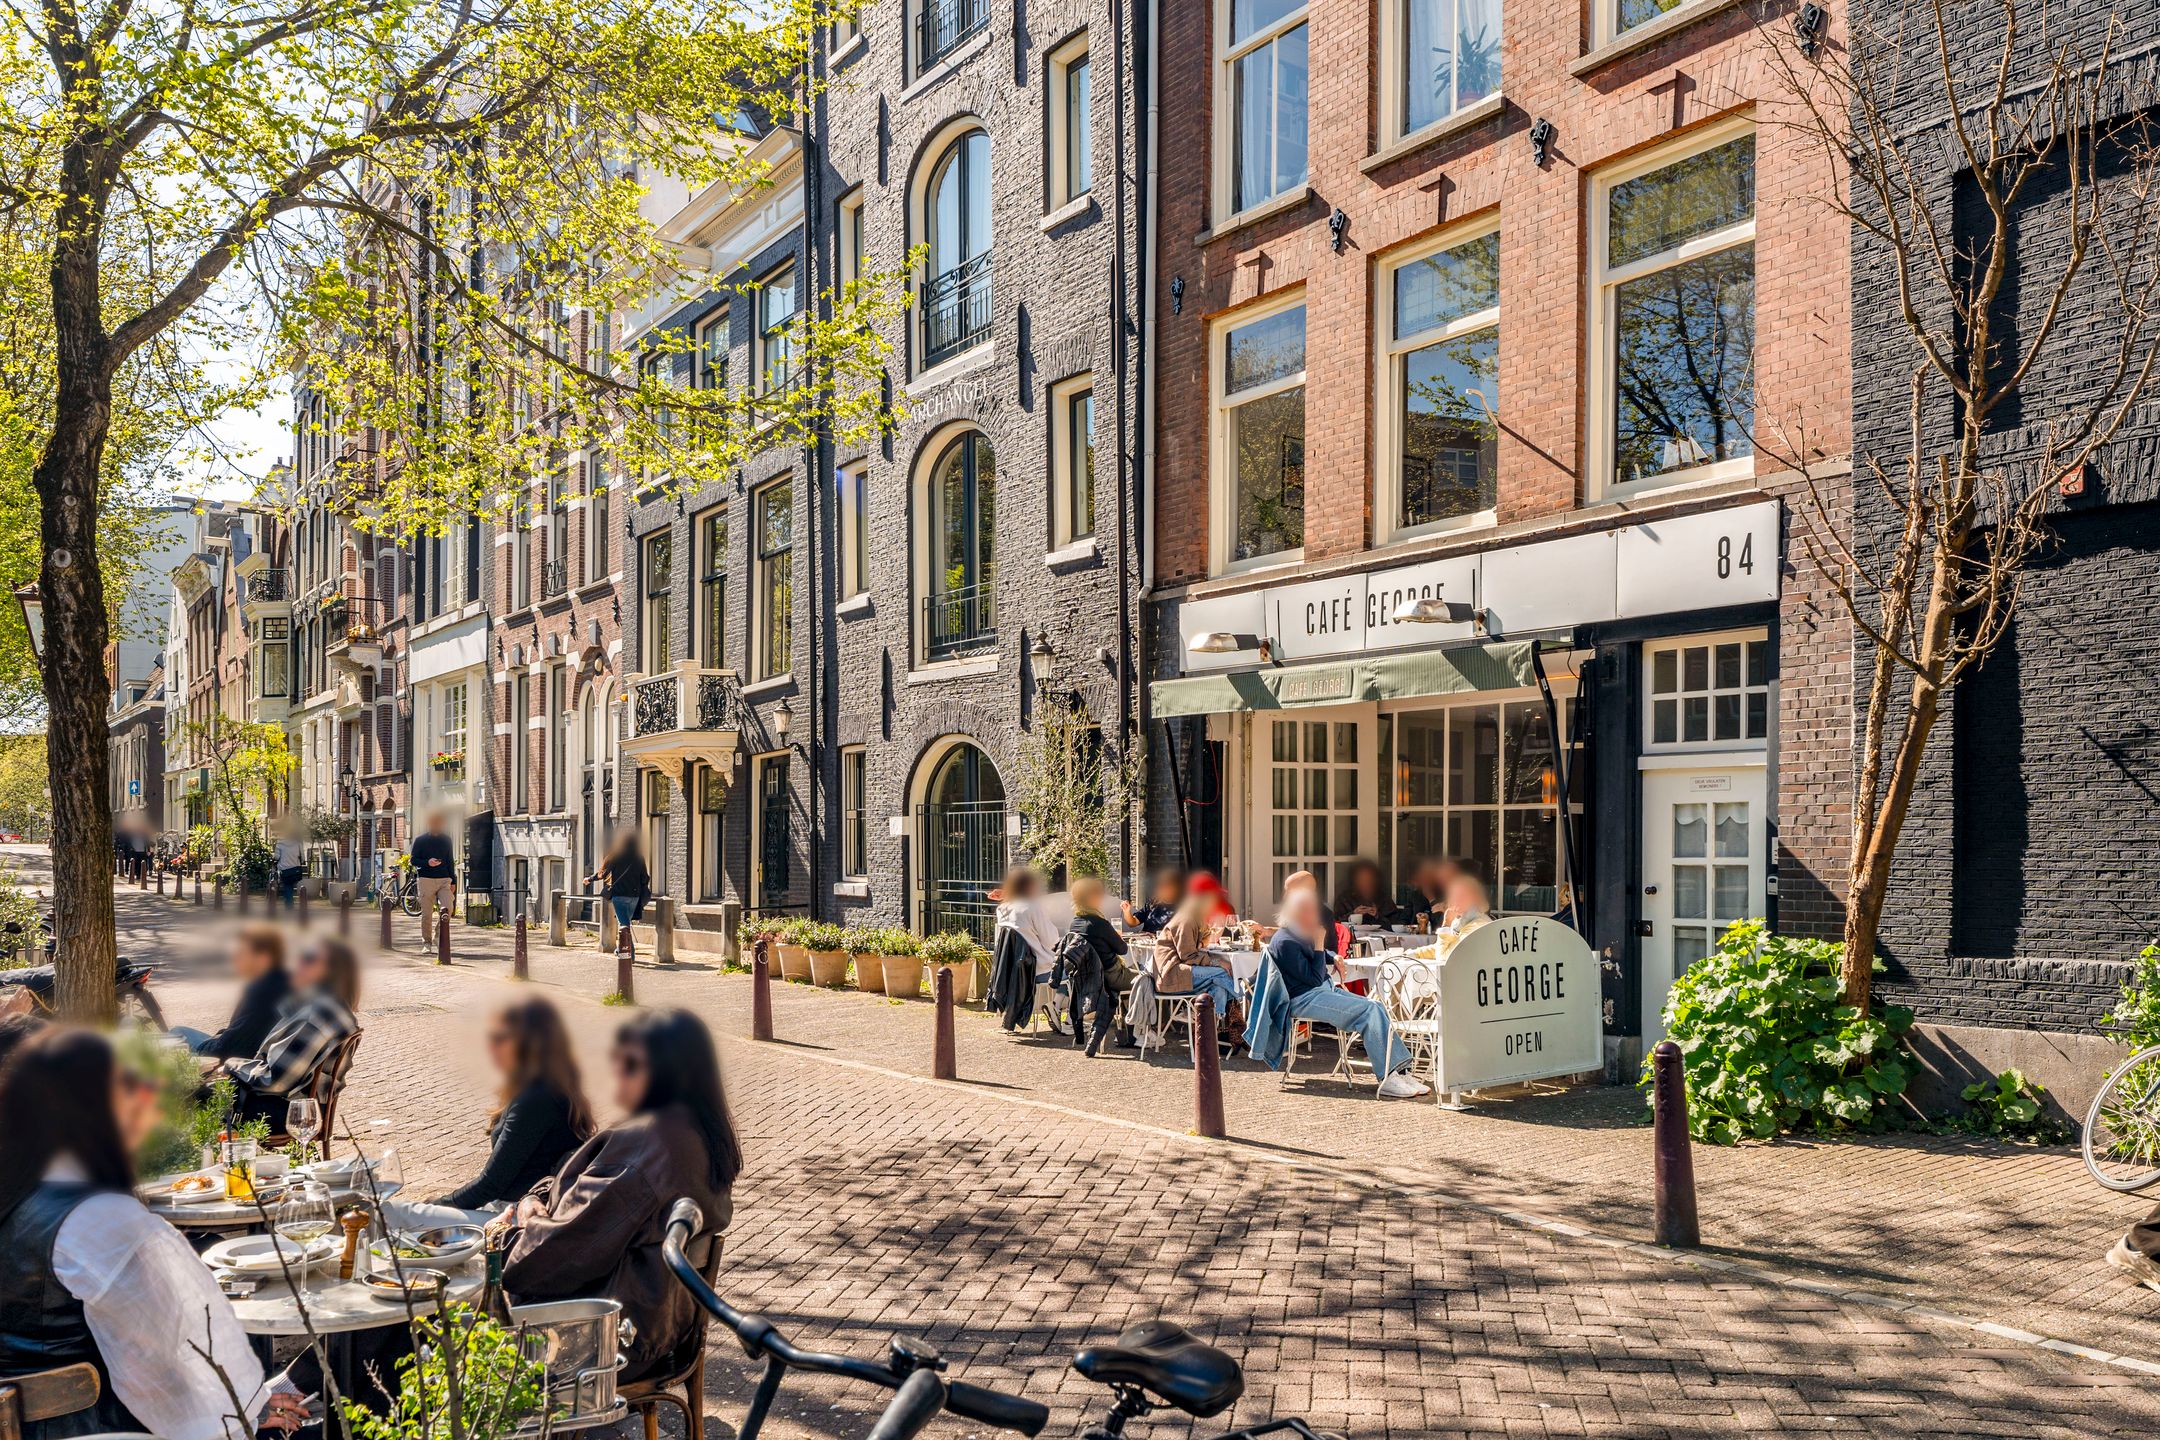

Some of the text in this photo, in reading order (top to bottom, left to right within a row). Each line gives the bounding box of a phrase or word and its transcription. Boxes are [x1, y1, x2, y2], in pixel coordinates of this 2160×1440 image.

[911, 378, 988, 423] ARCHANGEL
[1717, 532, 1754, 579] 84
[1306, 588, 1352, 634] CAFÉ
[1312, 676, 1345, 696] GEORGE
[1499, 920, 1539, 955] CAFÉ
[1477, 962, 1565, 1007] GEORGE
[1505, 1031, 1543, 1056] OPEN
